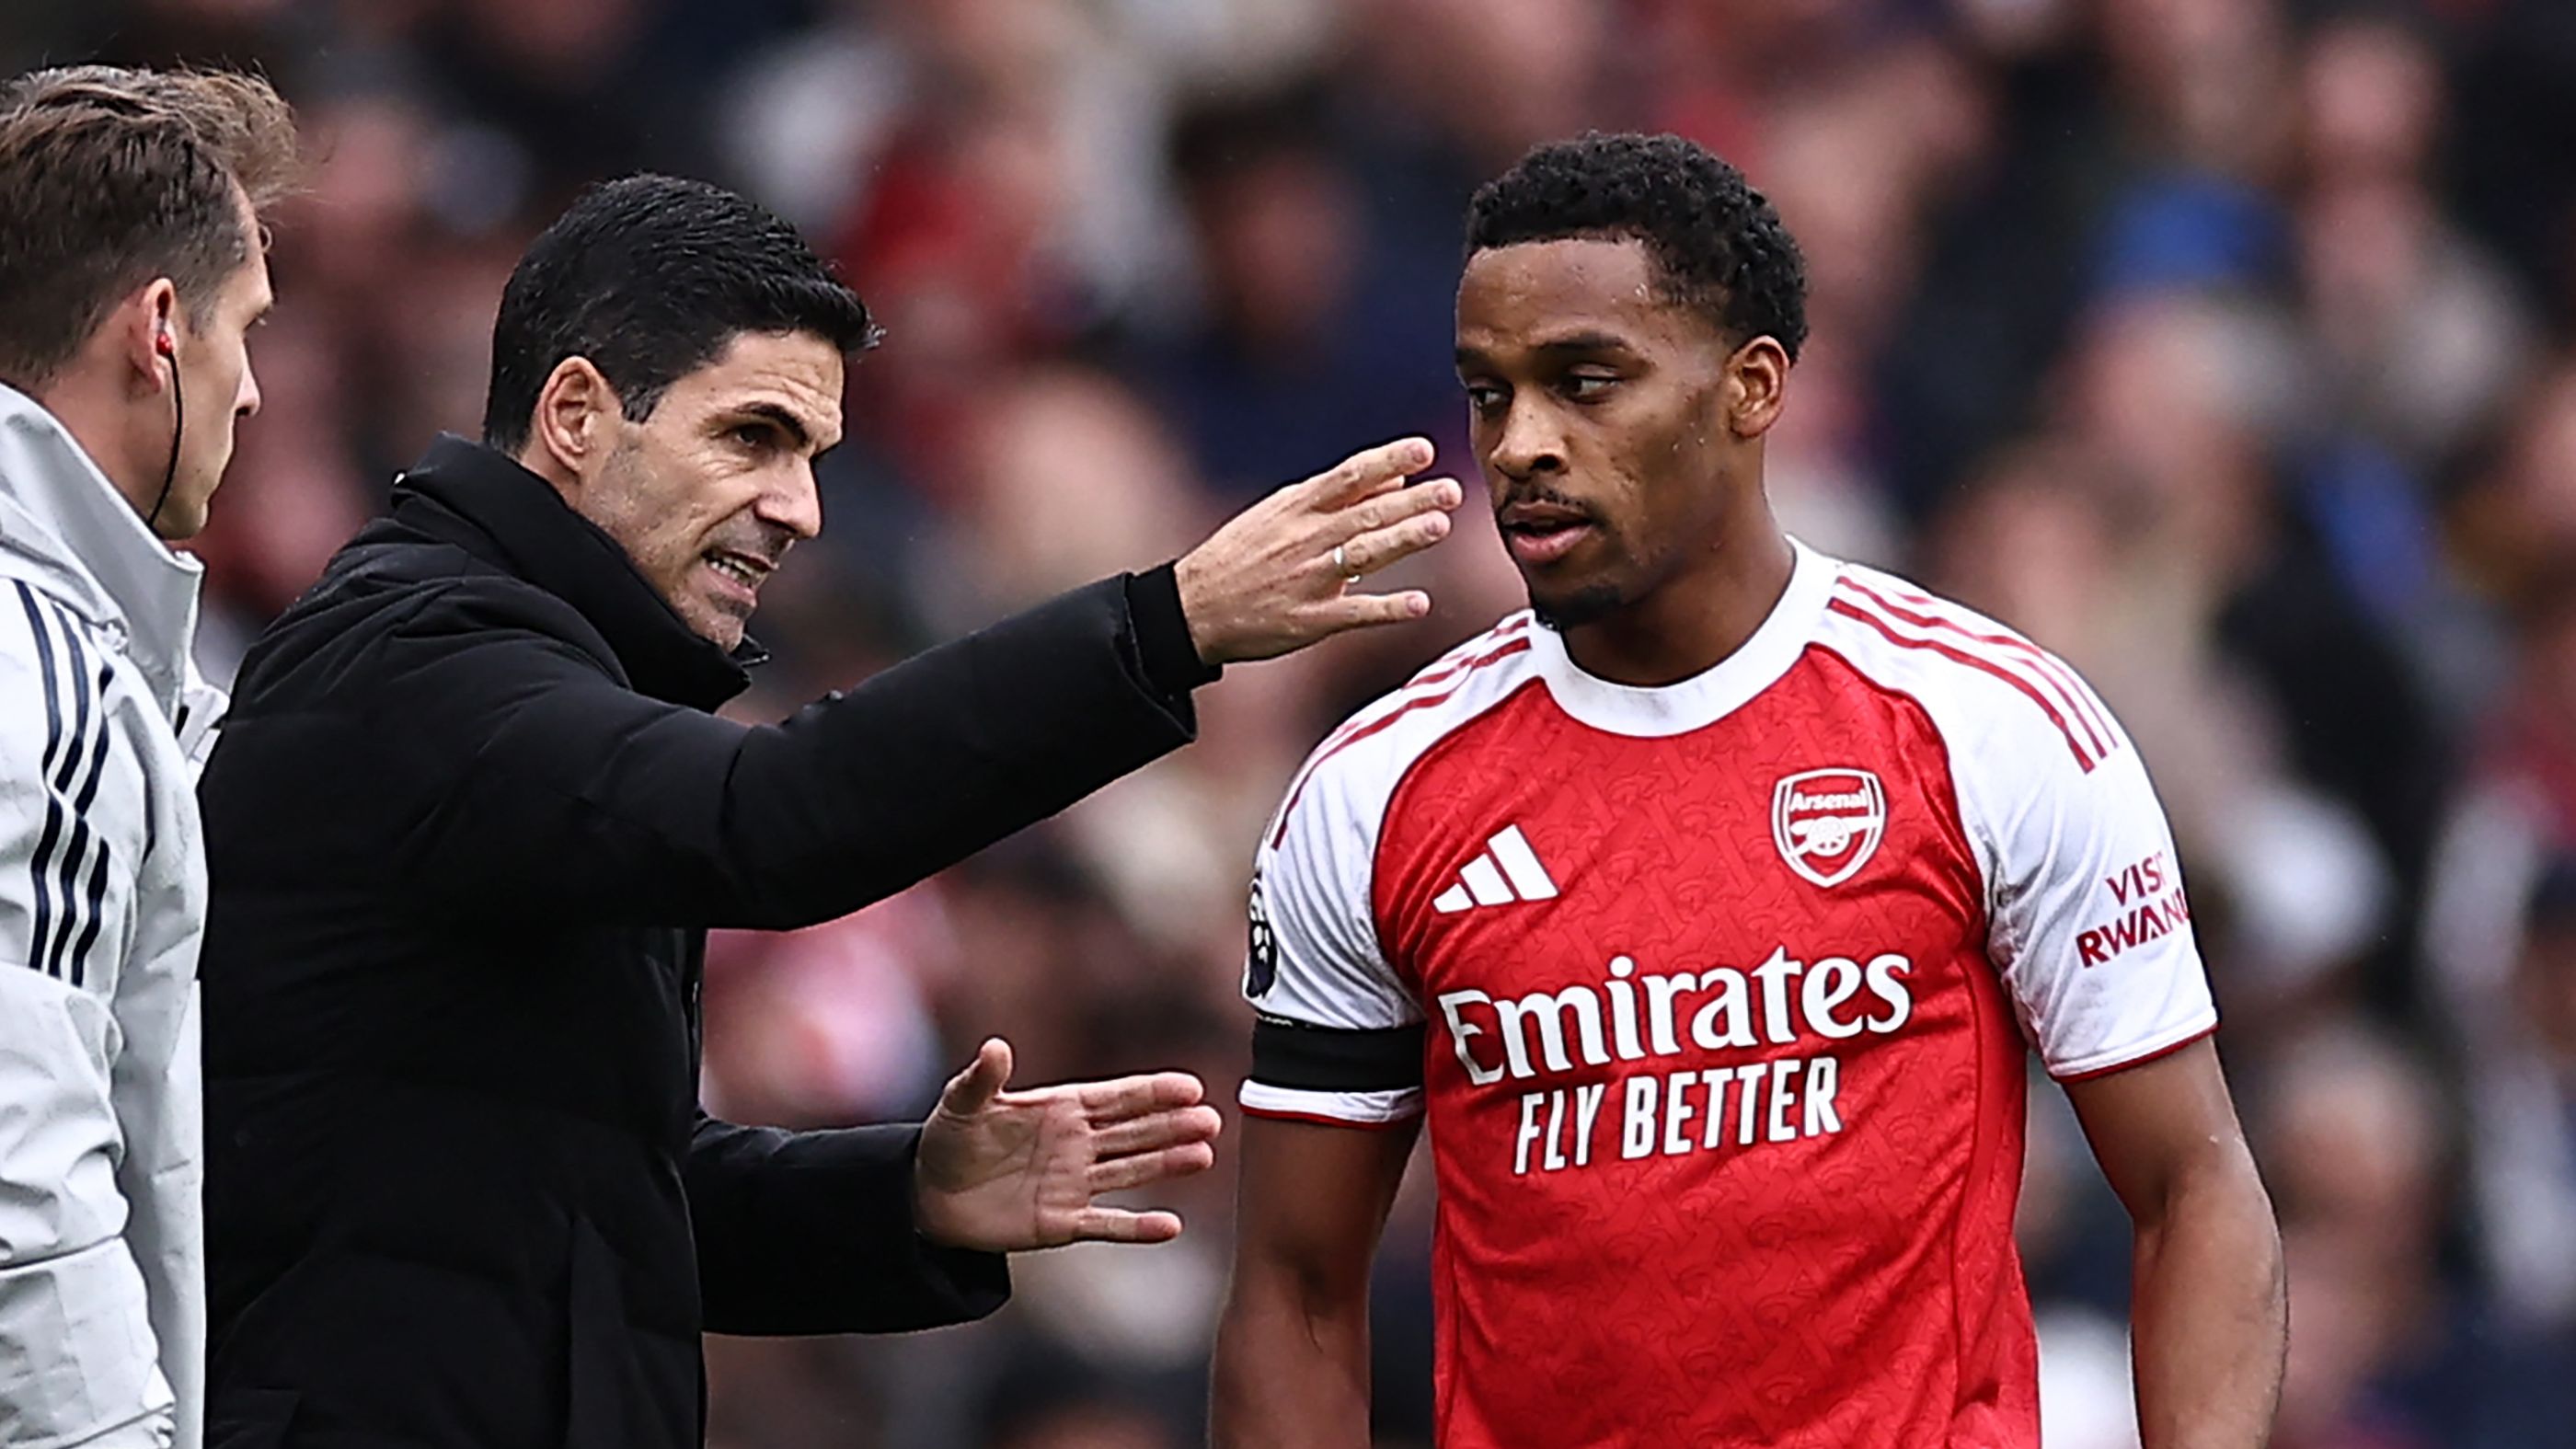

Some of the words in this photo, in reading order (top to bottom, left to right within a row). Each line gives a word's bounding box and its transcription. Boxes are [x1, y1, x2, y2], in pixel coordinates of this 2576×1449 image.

[1789, 788, 1868, 812] Arsenal
[1438, 945, 1912, 1086] Emirates
[1514, 1083, 1604, 1175] FLY
[1621, 1056, 1842, 1159] BETTER
